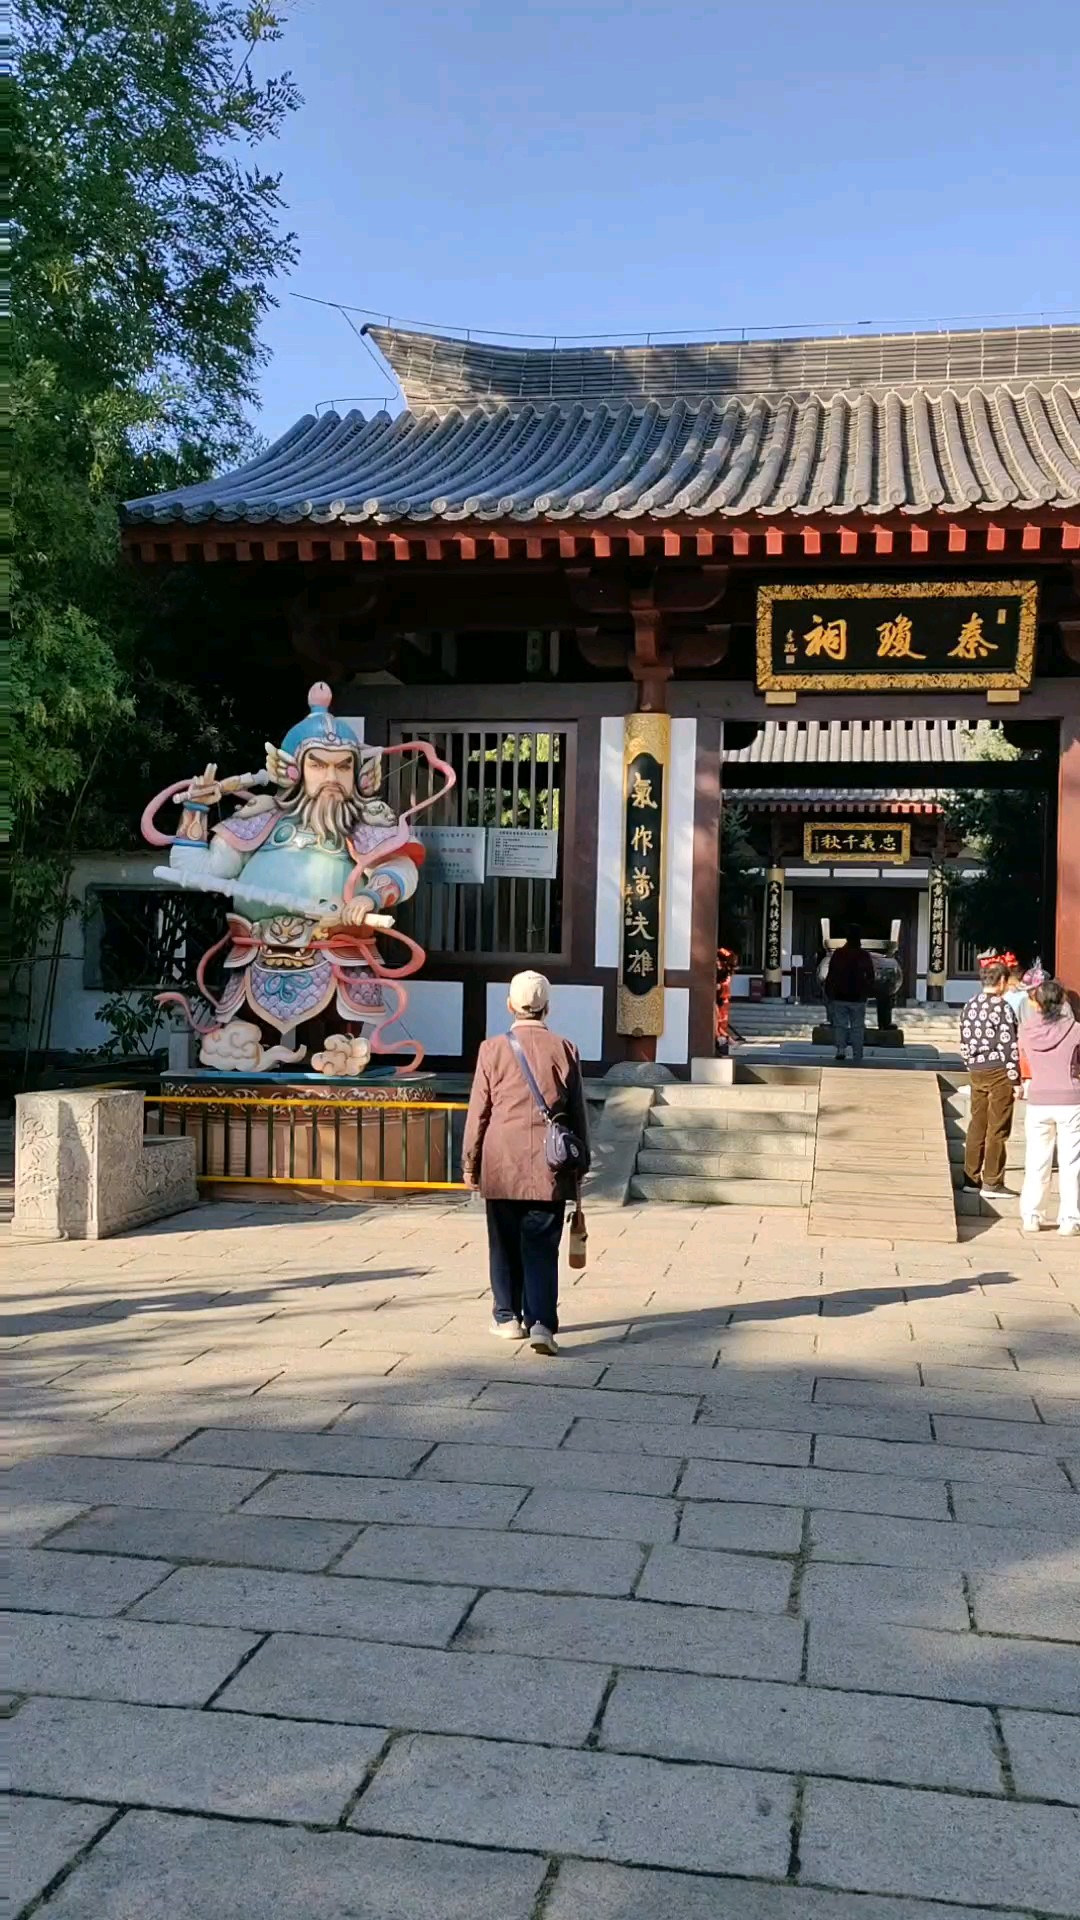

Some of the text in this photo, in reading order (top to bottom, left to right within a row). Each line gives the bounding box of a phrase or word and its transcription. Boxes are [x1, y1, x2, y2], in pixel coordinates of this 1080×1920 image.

[803, 612, 998, 661] 秦瓊祠
[820, 832, 897, 852] 忠義千秋
